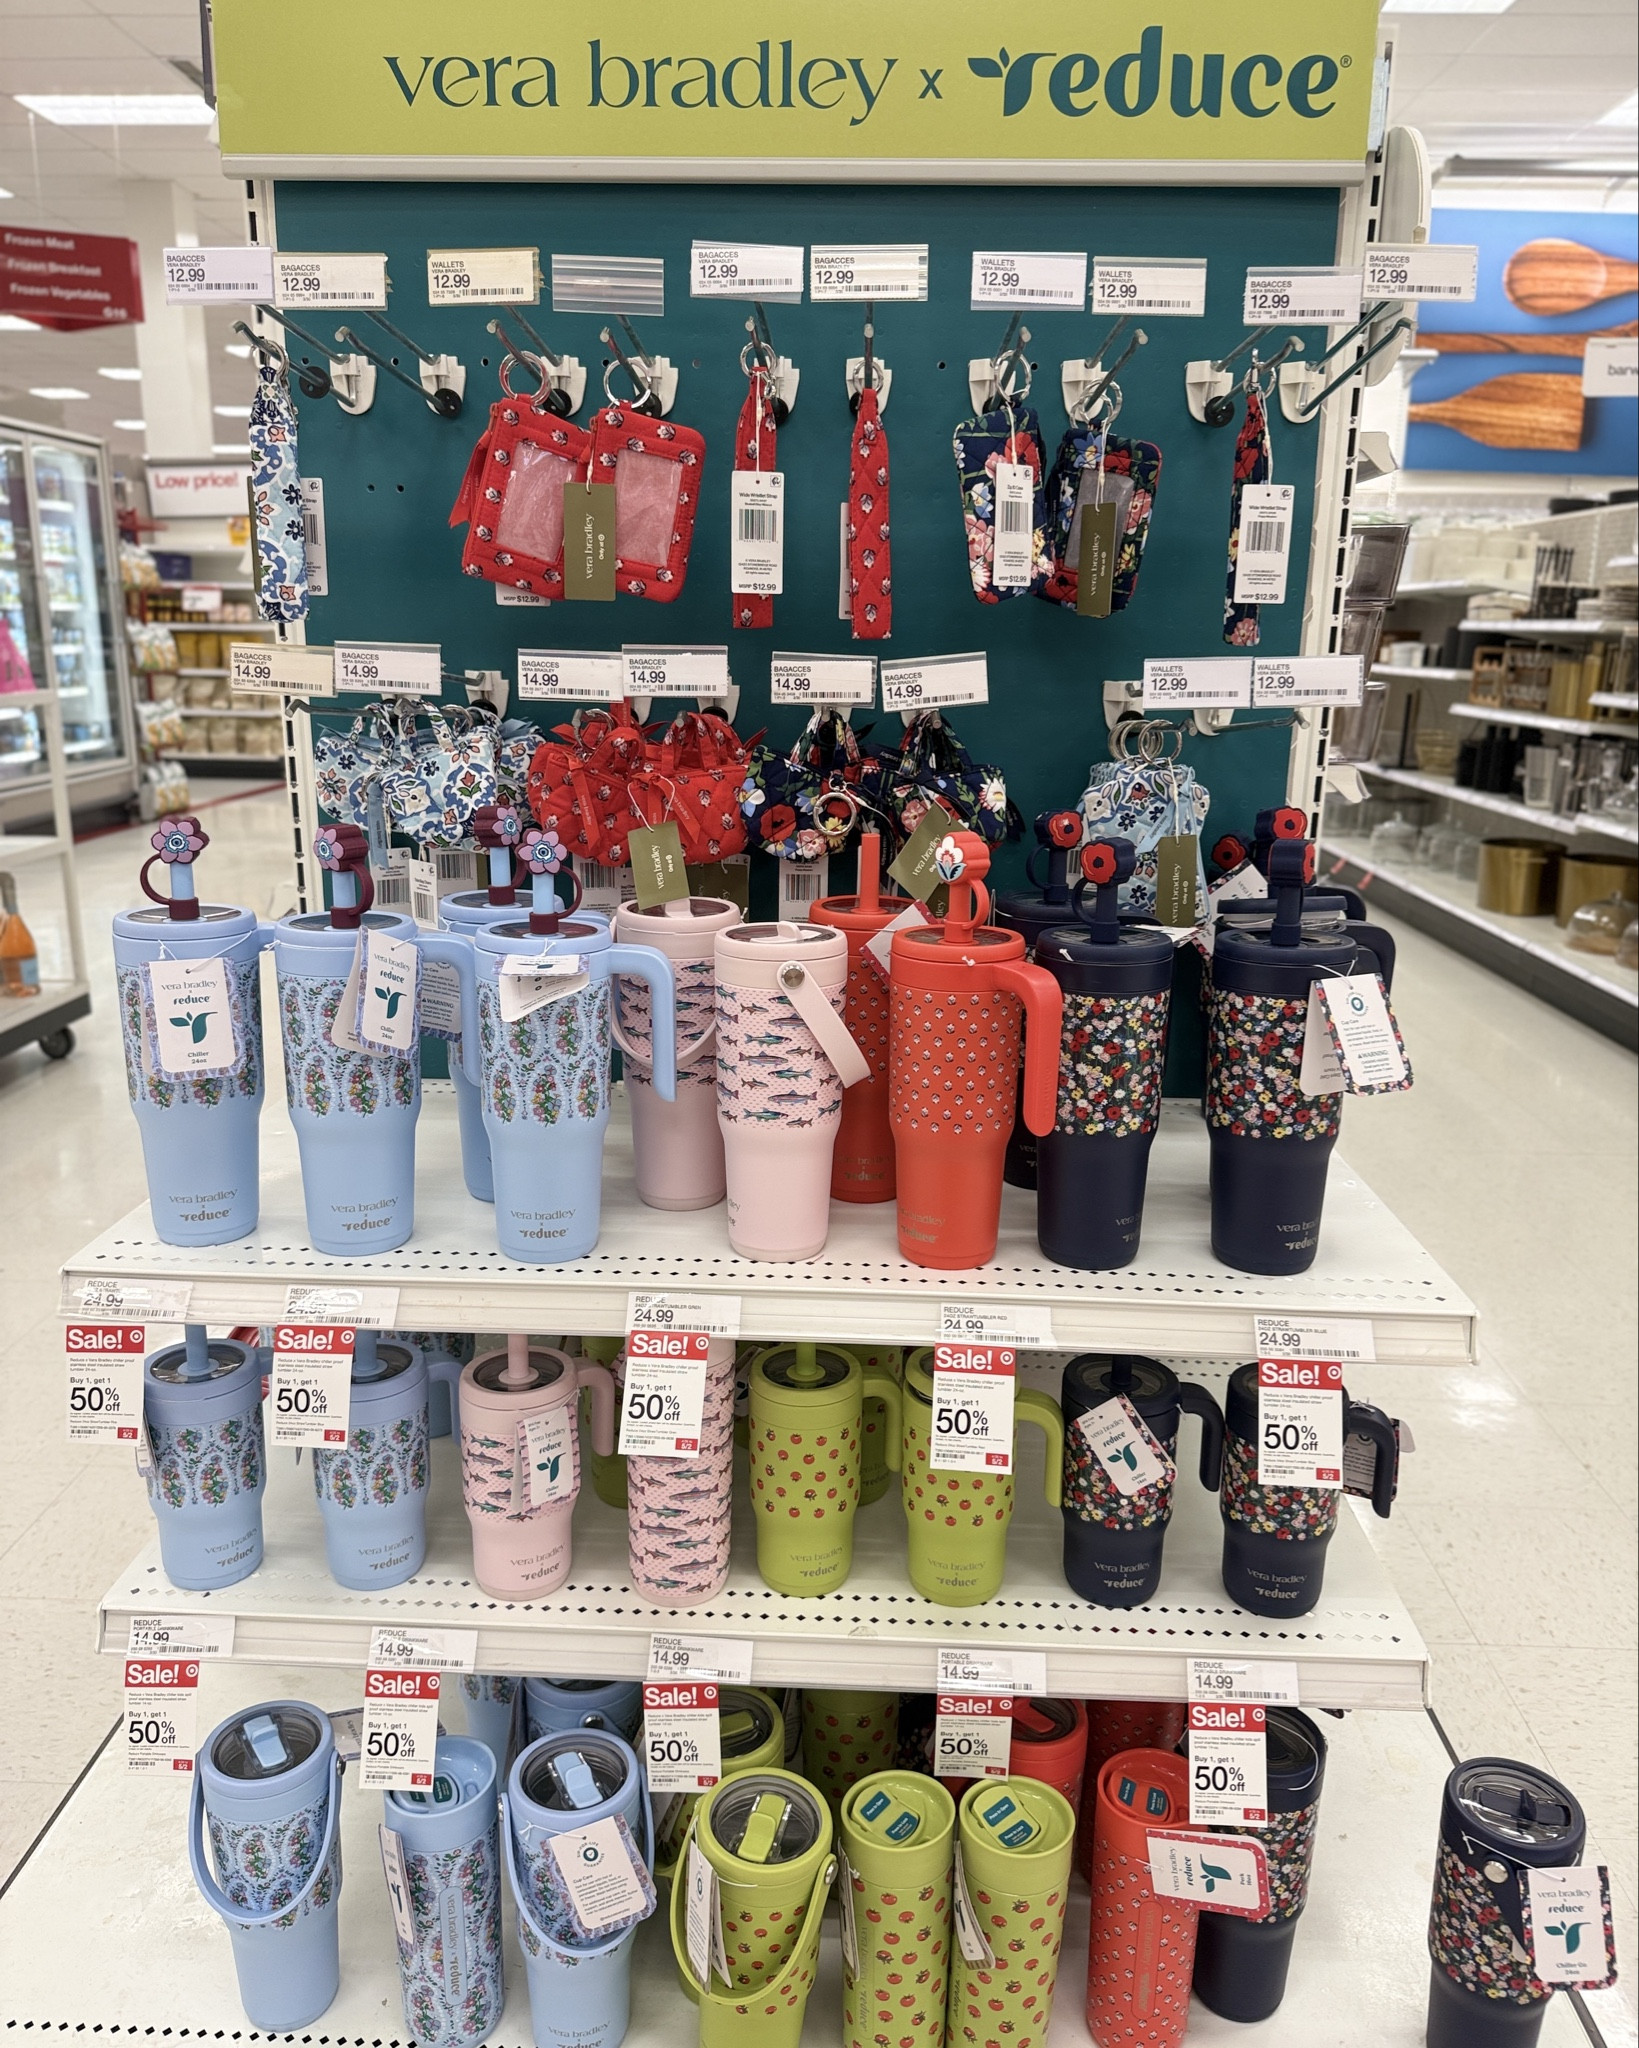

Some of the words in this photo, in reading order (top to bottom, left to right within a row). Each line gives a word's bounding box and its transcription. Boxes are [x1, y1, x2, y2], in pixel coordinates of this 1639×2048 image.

[383, 56, 560, 107] vera
[587, 39, 899, 126] bradley
[918, 69, 943, 99] x
[4, 233, 44, 246] Frozen
[45, 236, 75, 250] Meat
[698, 251, 739, 259] BAGACCES
[1369, 255, 1410, 264] BAGACCES
[7, 258, 47, 272] Frozen
[48, 262, 102, 277] Breakfast
[281, 264, 321, 272] BAGACCES
[981, 258, 1015, 267] WALLETS
[168, 268, 205, 282] 12.99
[700, 264, 738, 278] 12.99
[816, 270, 854, 284] 12.99
[1098, 270, 1132, 278] WALLETS
[1370, 269, 1408, 284] 12.99
[283, 277, 320, 291] 12.99
[433, 274, 470, 288] 12.99
[981, 271, 1019, 287] 12.99
[1250, 280, 1292, 288] BAGACCES
[10, 282, 49, 296] Frozen
[50, 286, 111, 301] Vegetables
[1099, 284, 1137, 298] 12.99
[1251, 294, 1290, 309] 12.99
[155, 473, 188, 489] Low
[194, 472, 238, 493] price!
[585, 513, 595, 553] bradley
[1009, 575, 1026, 583] $12.99
[753, 583, 776, 591] $12.99
[517, 595, 540, 603] $12.99
[234, 652, 272, 661] BAGACCES
[342, 652, 380, 661] BAGACCES
[629, 658, 667, 667] BAGACCES
[235, 664, 271, 679] 14.99
[343, 664, 378, 679] 14.99
[521, 660, 560, 669] BAGACCES
[523, 673, 559, 687] 14.99
[630, 670, 666, 683] 14.99
[884, 673, 922, 683] BAGACCES
[1258, 676, 1295, 689] 12.99
[775, 678, 810, 691] 14.99
[1151, 677, 1188, 691] 12.99
[887, 684, 922, 699] 14.99
[1173, 863, 1182, 900] bradley
[374, 953, 388, 964] vera
[389, 956, 411, 972] bradley
[161, 982, 186, 991] vera
[187, 979, 217, 992] bradley
[169, 1196, 193, 1204] vera
[194, 1188, 238, 1203] bradley
[331, 1205, 356, 1213] vera
[354, 1196, 398, 1212] bradley
[510, 1210, 532, 1220] vera
[533, 1208, 576, 1223] bradley
[634, 1308, 674, 1323] 24.99
[944, 1306, 974, 1314] REDUCE
[1257, 1319, 1289, 1327] REDUCE
[68, 1329, 122, 1349] Sale!
[277, 1328, 334, 1350] Sale!
[632, 1334, 688, 1356] Sale!
[1259, 1332, 1301, 1347] 24.99
[936, 1347, 992, 1370] Sale!
[1261, 1362, 1320, 1385] Sale!
[630, 1382, 644, 1391] Buy
[105, 1402, 120, 1411] off
[311, 1404, 327, 1413] off
[664, 1411, 681, 1421] off
[1264, 1413, 1278, 1421] Buy
[972, 1426, 989, 1436] off
[1301, 1441, 1318, 1451] off
[510, 1557, 533, 1567] vera
[536, 1544, 565, 1563] bradley
[1094, 1562, 1118, 1572] vera
[1119, 1561, 1150, 1573] bradley
[133, 1619, 162, 1627] REDUCE
[653, 1637, 682, 1646] REDUCE
[378, 1642, 414, 1657] 14.99
[941, 1652, 970, 1660] REDUCE
[653, 1650, 689, 1666] 14.99
[1194, 1661, 1223, 1669] REDUCE
[127, 1664, 179, 1684] Sale!
[941, 1666, 979, 1681] 14.99
[368, 1674, 421, 1695] Sale!
[1195, 1674, 1233, 1689] 14.99
[645, 1687, 697, 1706] Sale!
[939, 1698, 992, 1714] Sale!
[1192, 1706, 1245, 1728] Sale!
[161, 1734, 176, 1744] off
[400, 1747, 415, 1757] off
[683, 1750, 698, 1762] off
[973, 1747, 988, 1756] off
[1194, 1755, 1208, 1763] Buy
[1229, 1782, 1245, 1792] off
[1537, 1890, 1557, 1898] vera
[1559, 1889, 1592, 1899] bradley
